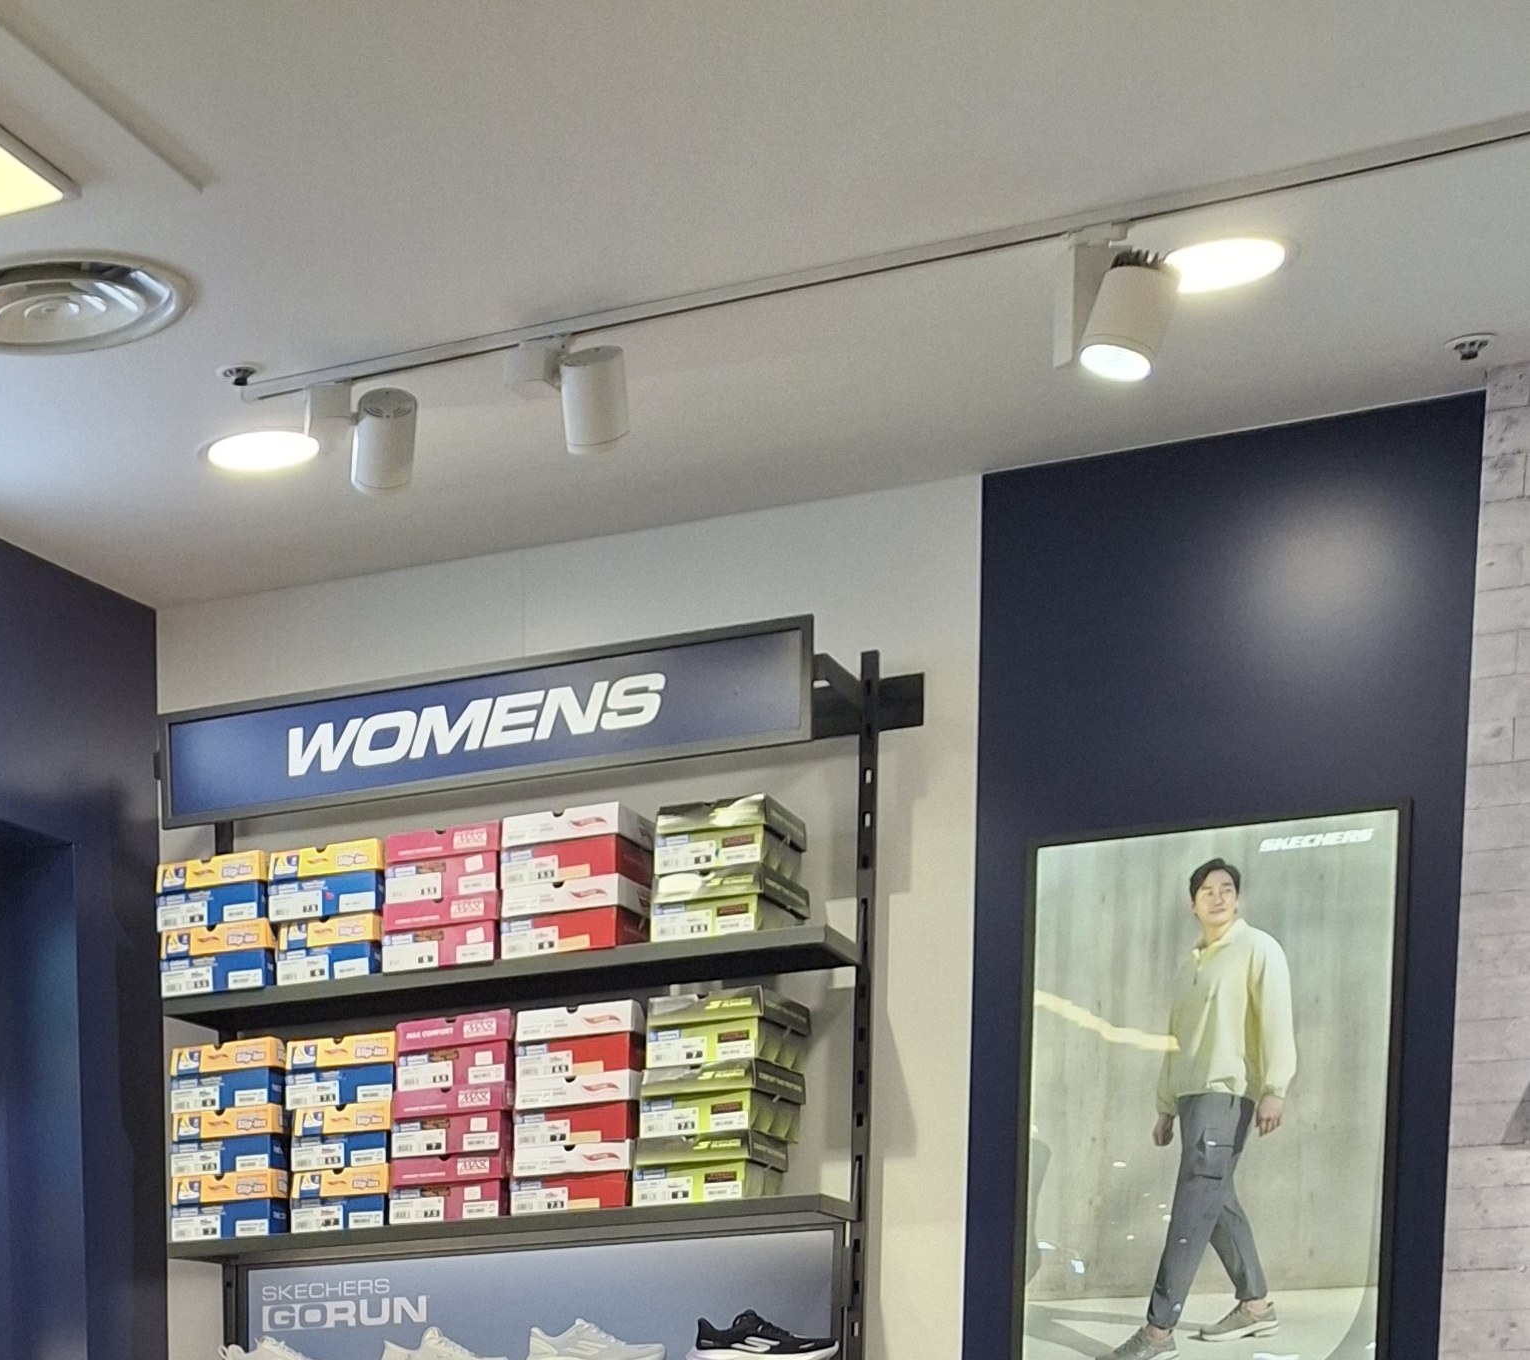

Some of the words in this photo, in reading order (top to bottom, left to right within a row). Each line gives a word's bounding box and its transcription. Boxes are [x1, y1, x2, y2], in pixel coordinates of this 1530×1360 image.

[286, 672, 667, 778] WOMENS
[1258, 827, 1374, 853] SKECHERS
[261, 1278, 390, 1302] SKECHERS
